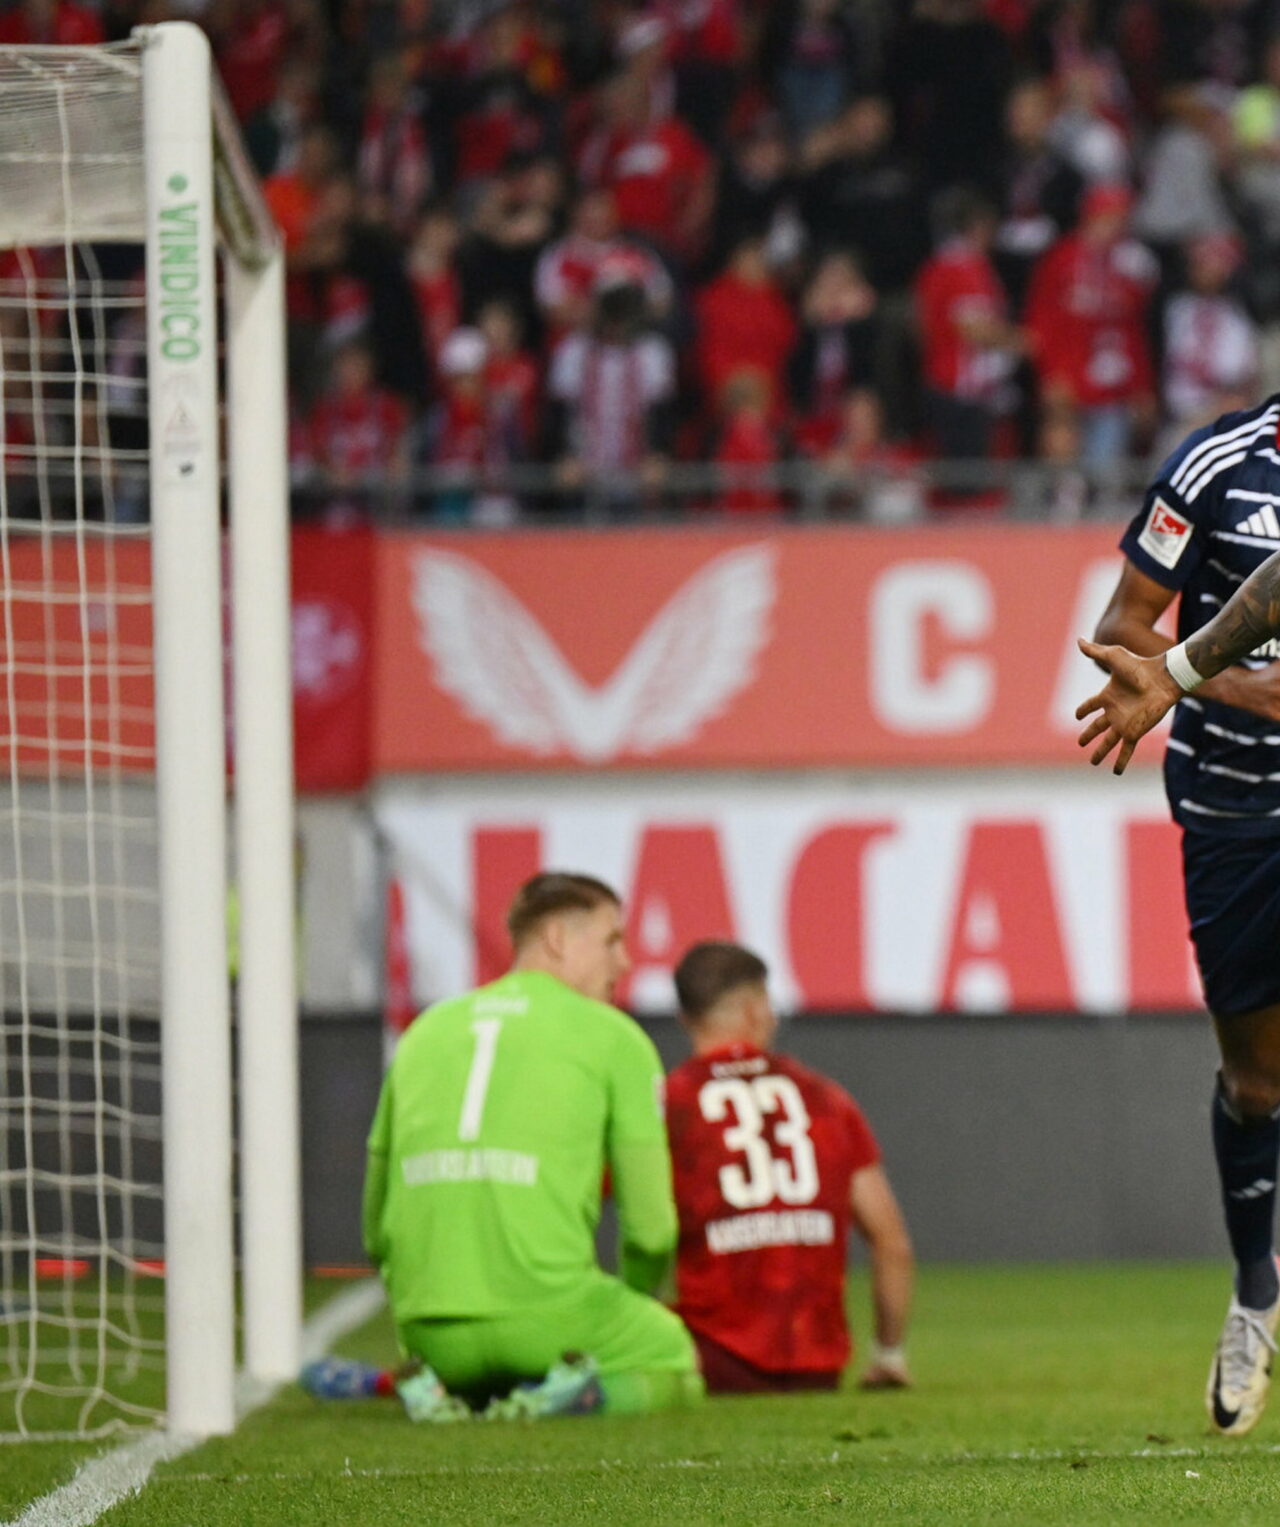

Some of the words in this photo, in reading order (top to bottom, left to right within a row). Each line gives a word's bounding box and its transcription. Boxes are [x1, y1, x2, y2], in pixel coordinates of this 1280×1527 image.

[158, 203, 201, 361] VINDICO
[456, 1018, 503, 1143] 1
[699, 1074, 821, 1210] 33
